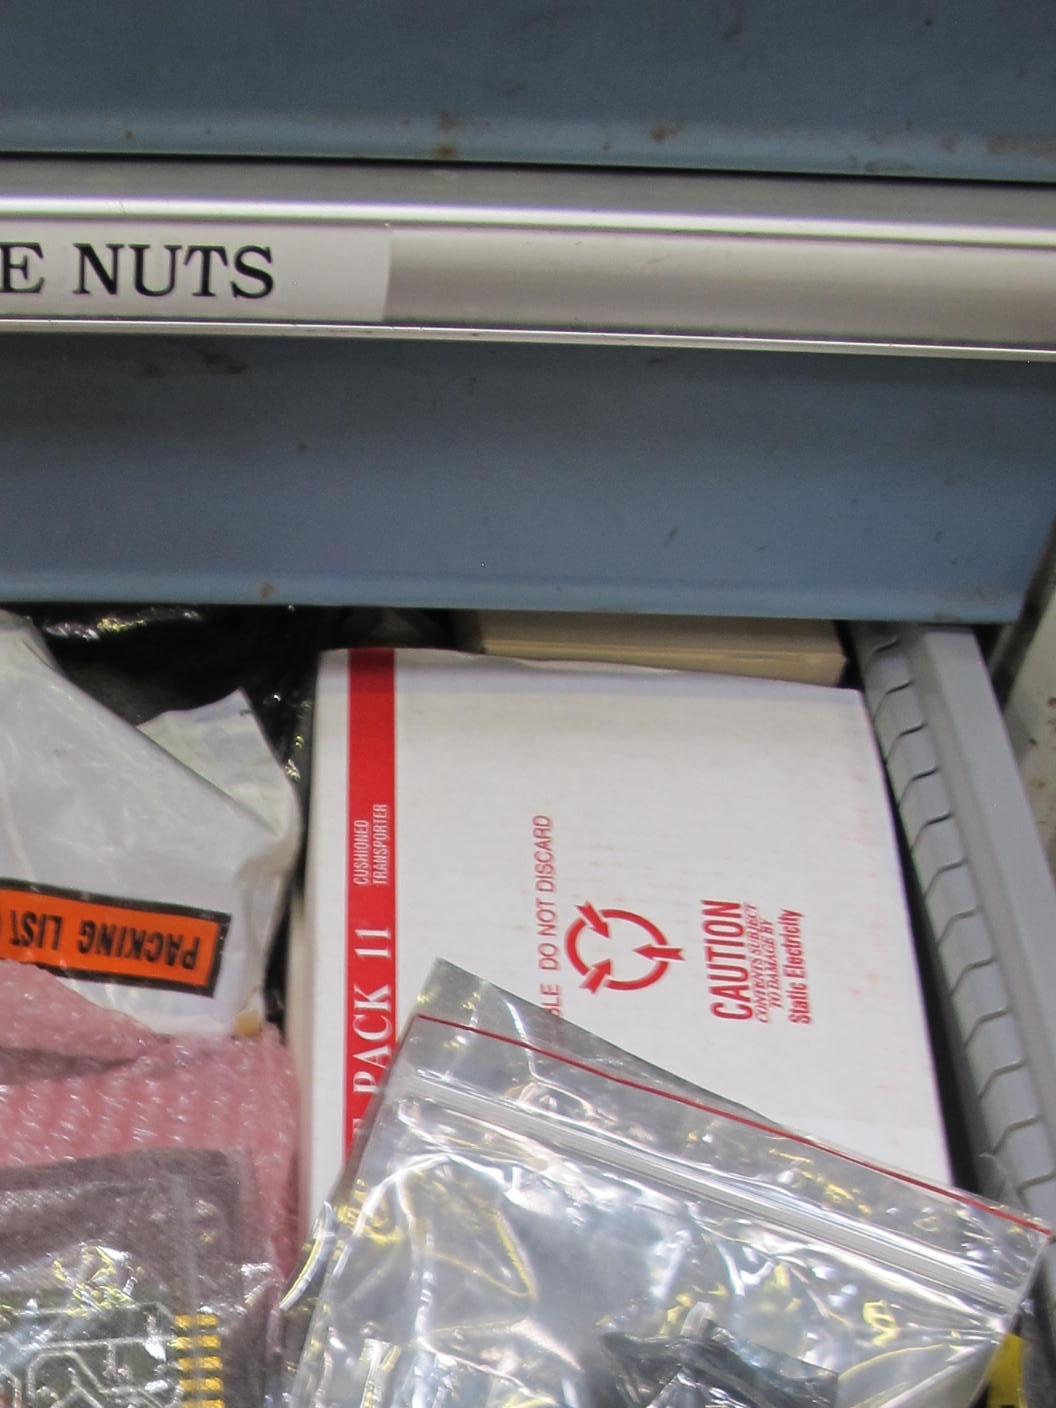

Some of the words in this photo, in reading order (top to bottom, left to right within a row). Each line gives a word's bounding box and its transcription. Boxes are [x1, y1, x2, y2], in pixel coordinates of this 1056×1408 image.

[72, 241, 275, 300] NUTS
[353, 819, 370, 886] CUSHIONED
[372, 803, 389, 886] TRANSPORTER
[532, 814, 556, 893] DISCARD
[10, 909, 62, 953] LIST
[77, 919, 201, 971] PACKING
[355, 927, 392, 962] 11
[535, 897, 558, 939] NOT
[777, 908, 807, 980] Electricity
[539, 943, 560, 971] DO
[700, 899, 753, 1020] CAUTION
[786, 981, 812, 1025] Static
[352, 983, 393, 1094] PACK
